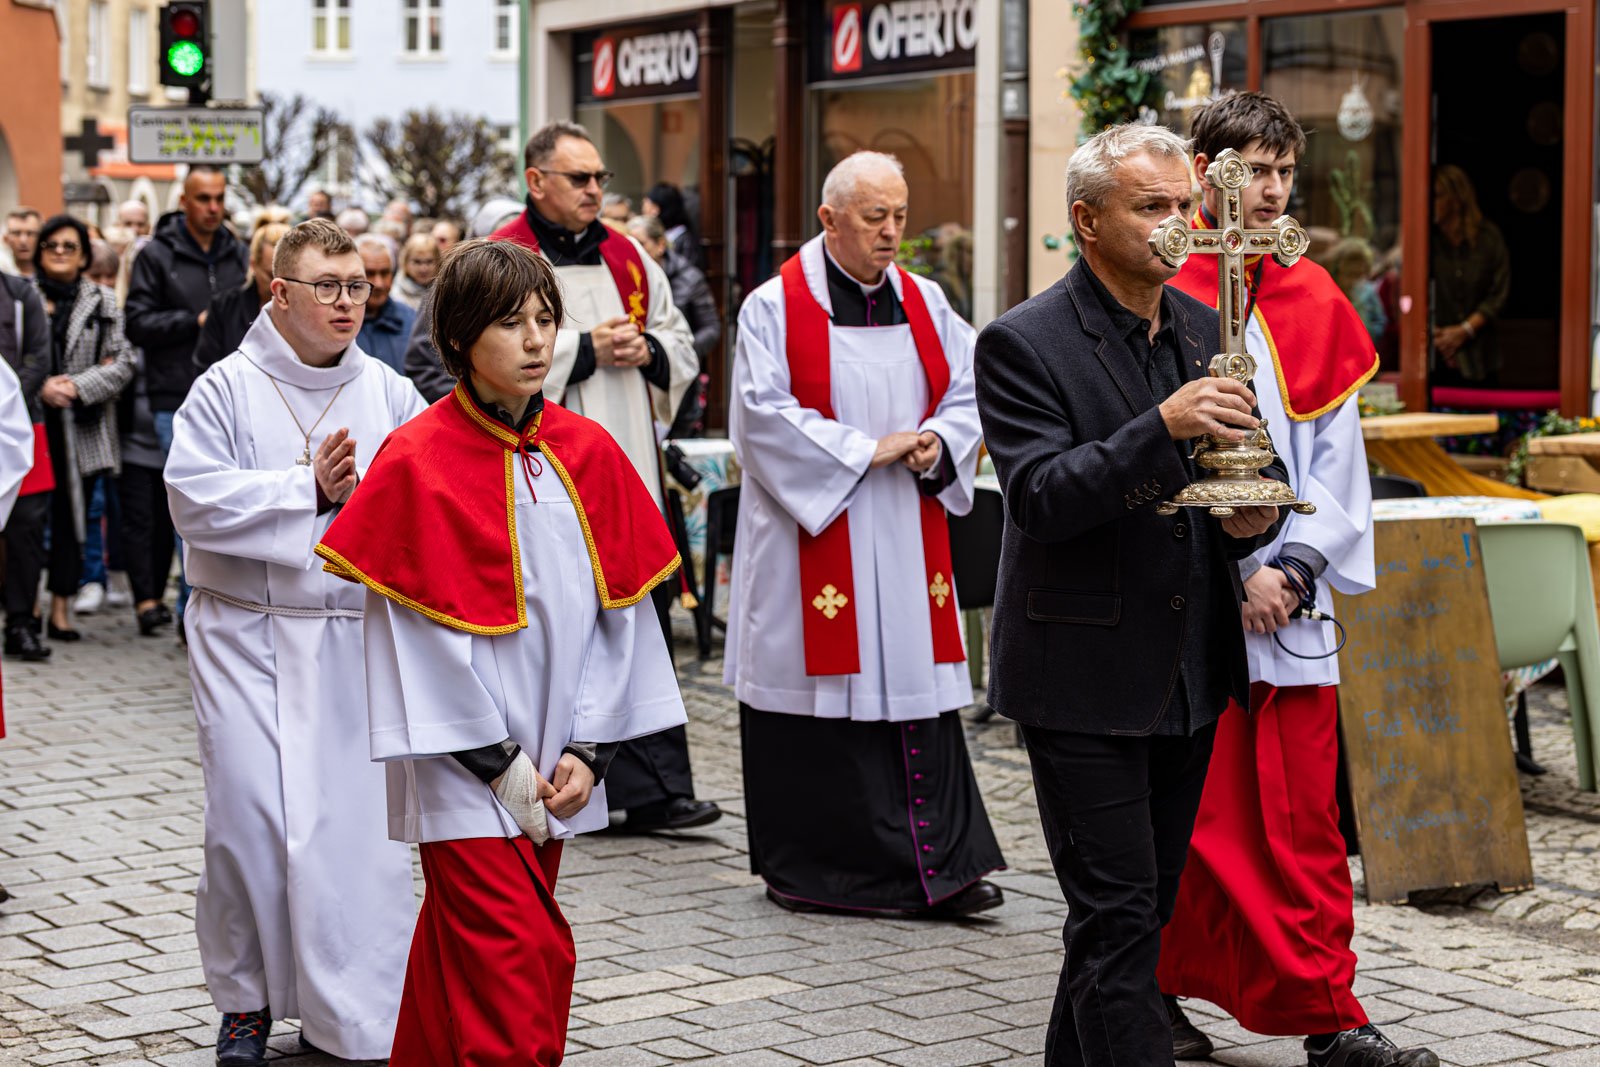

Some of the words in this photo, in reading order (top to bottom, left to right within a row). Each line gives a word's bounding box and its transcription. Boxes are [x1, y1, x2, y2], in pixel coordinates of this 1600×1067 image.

[867, 0, 977, 61] OFERTO
[617, 29, 698, 87] OFERTO
[134, 115, 182, 127] Centrum
[1363, 708, 1405, 741] Flat
